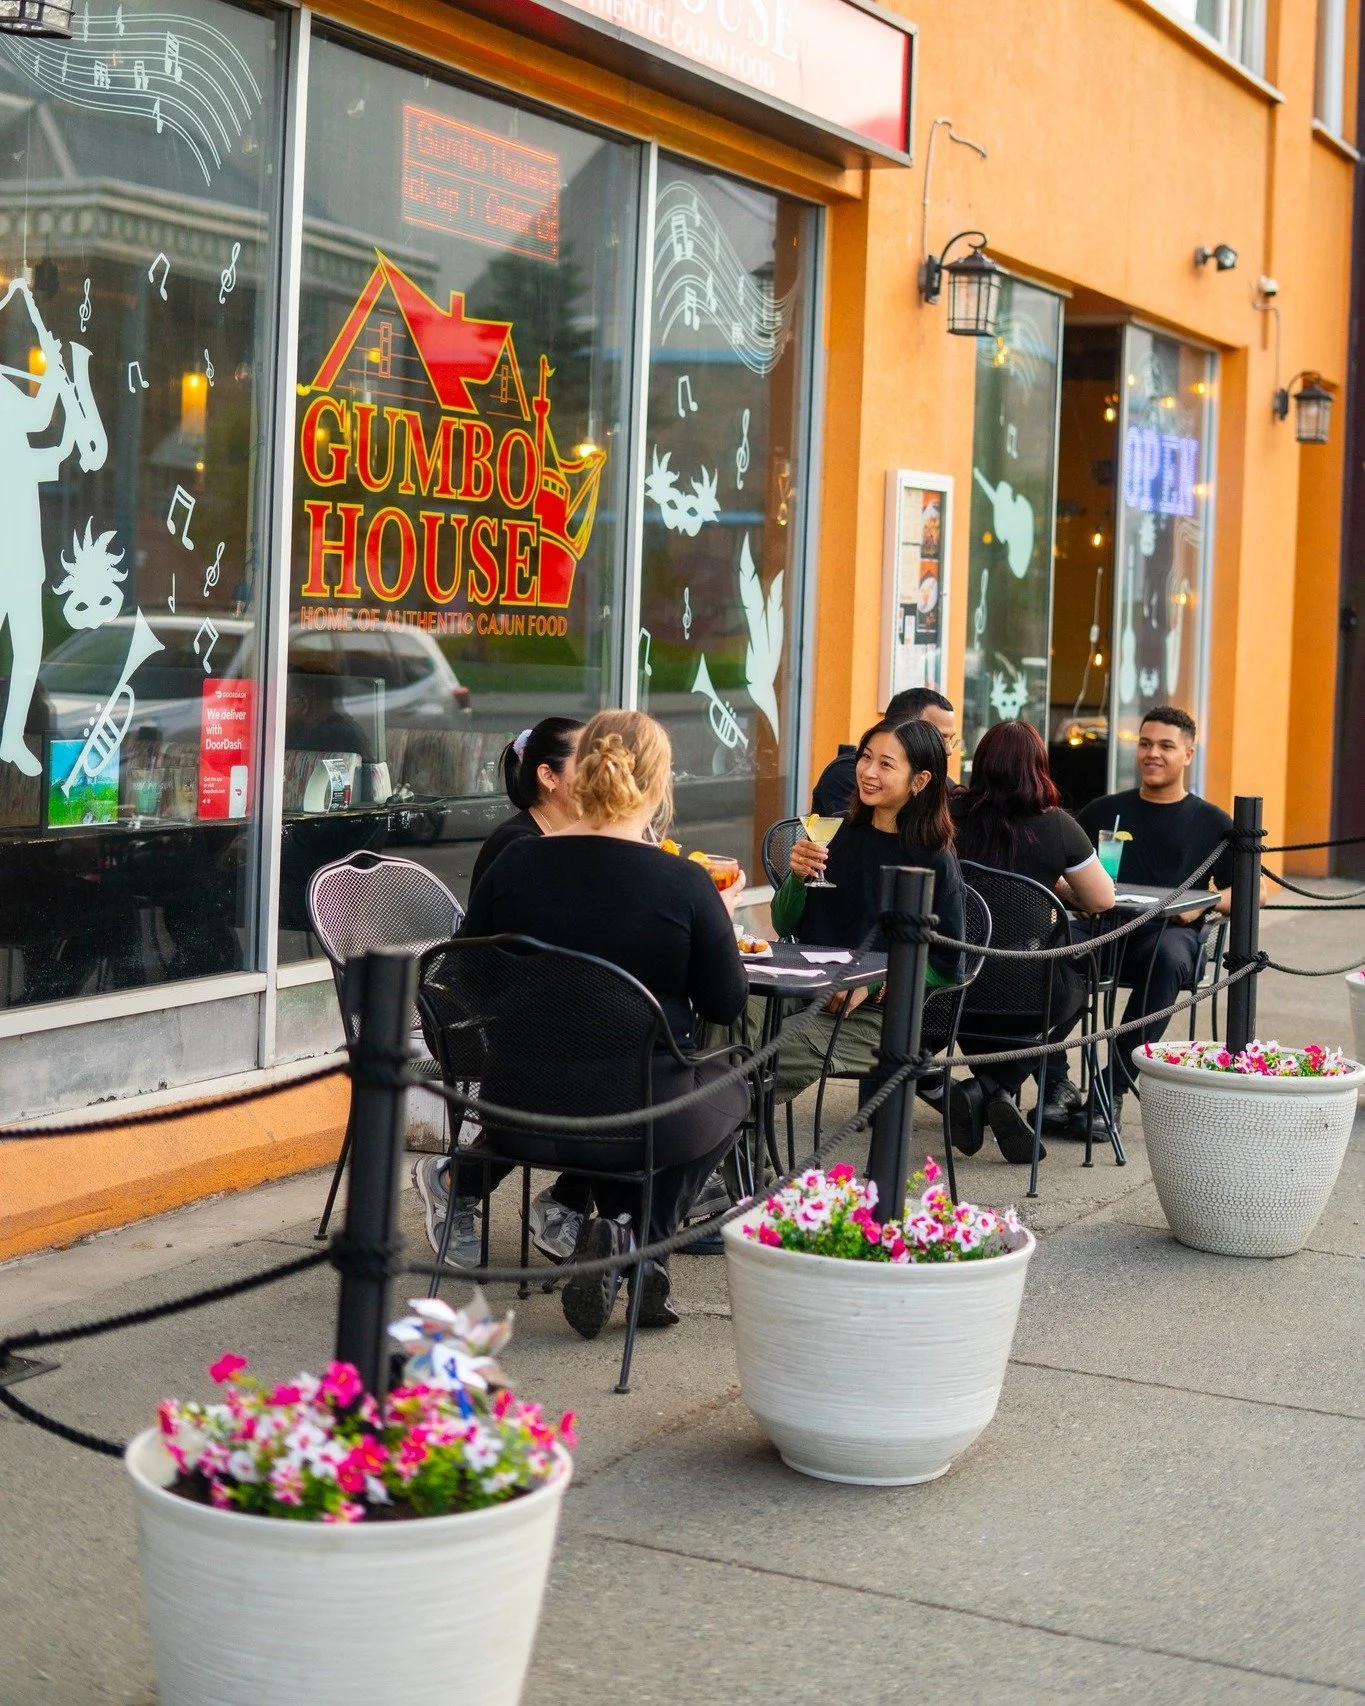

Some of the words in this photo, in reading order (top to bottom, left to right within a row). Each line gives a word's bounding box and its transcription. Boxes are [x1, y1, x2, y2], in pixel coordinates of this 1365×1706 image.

[671, 18, 726, 65] CAJUN
[730, 45, 776, 89] FOOD
[301, 395, 538, 510] GUMBO
[1124, 426, 1198, 516] OPEN
[301, 500, 538, 606] HOUSE
[300, 606, 353, 631] HOME
[357, 608, 381, 632] OF
[383, 609, 474, 635] AUTHENTIC
[476, 613, 526, 636] CAJUN
[527, 615, 569, 637] FOOD
[205, 724, 222, 735] with
[206, 708, 220, 720] We
[221, 708, 247, 720] deliver
[205, 738, 242, 750] DoorDash
